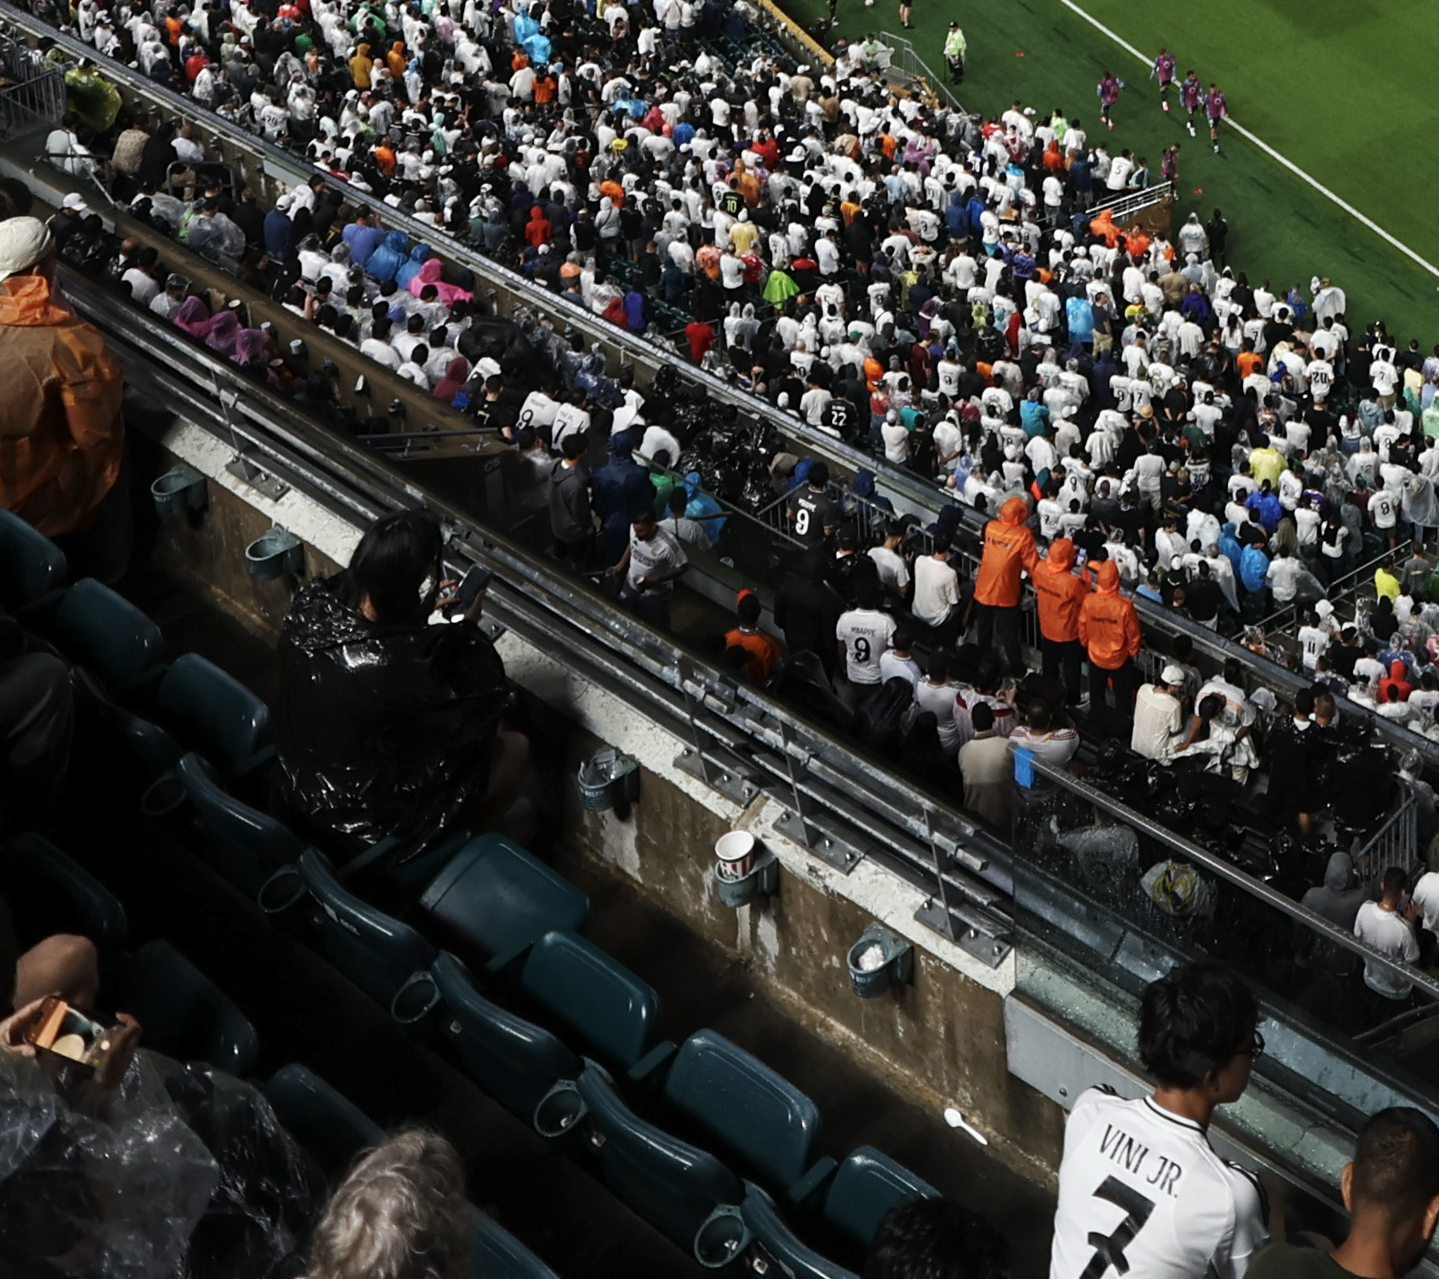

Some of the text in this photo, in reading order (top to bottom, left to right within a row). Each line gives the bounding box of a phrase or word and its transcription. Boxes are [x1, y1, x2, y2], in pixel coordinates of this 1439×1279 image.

[831, 410, 847, 426] 22
[795, 508, 810, 536] 9
[853, 637, 870, 664] 9
[1099, 1124, 1182, 1199] VINI JR.
[1077, 1174, 1157, 1279] 7
